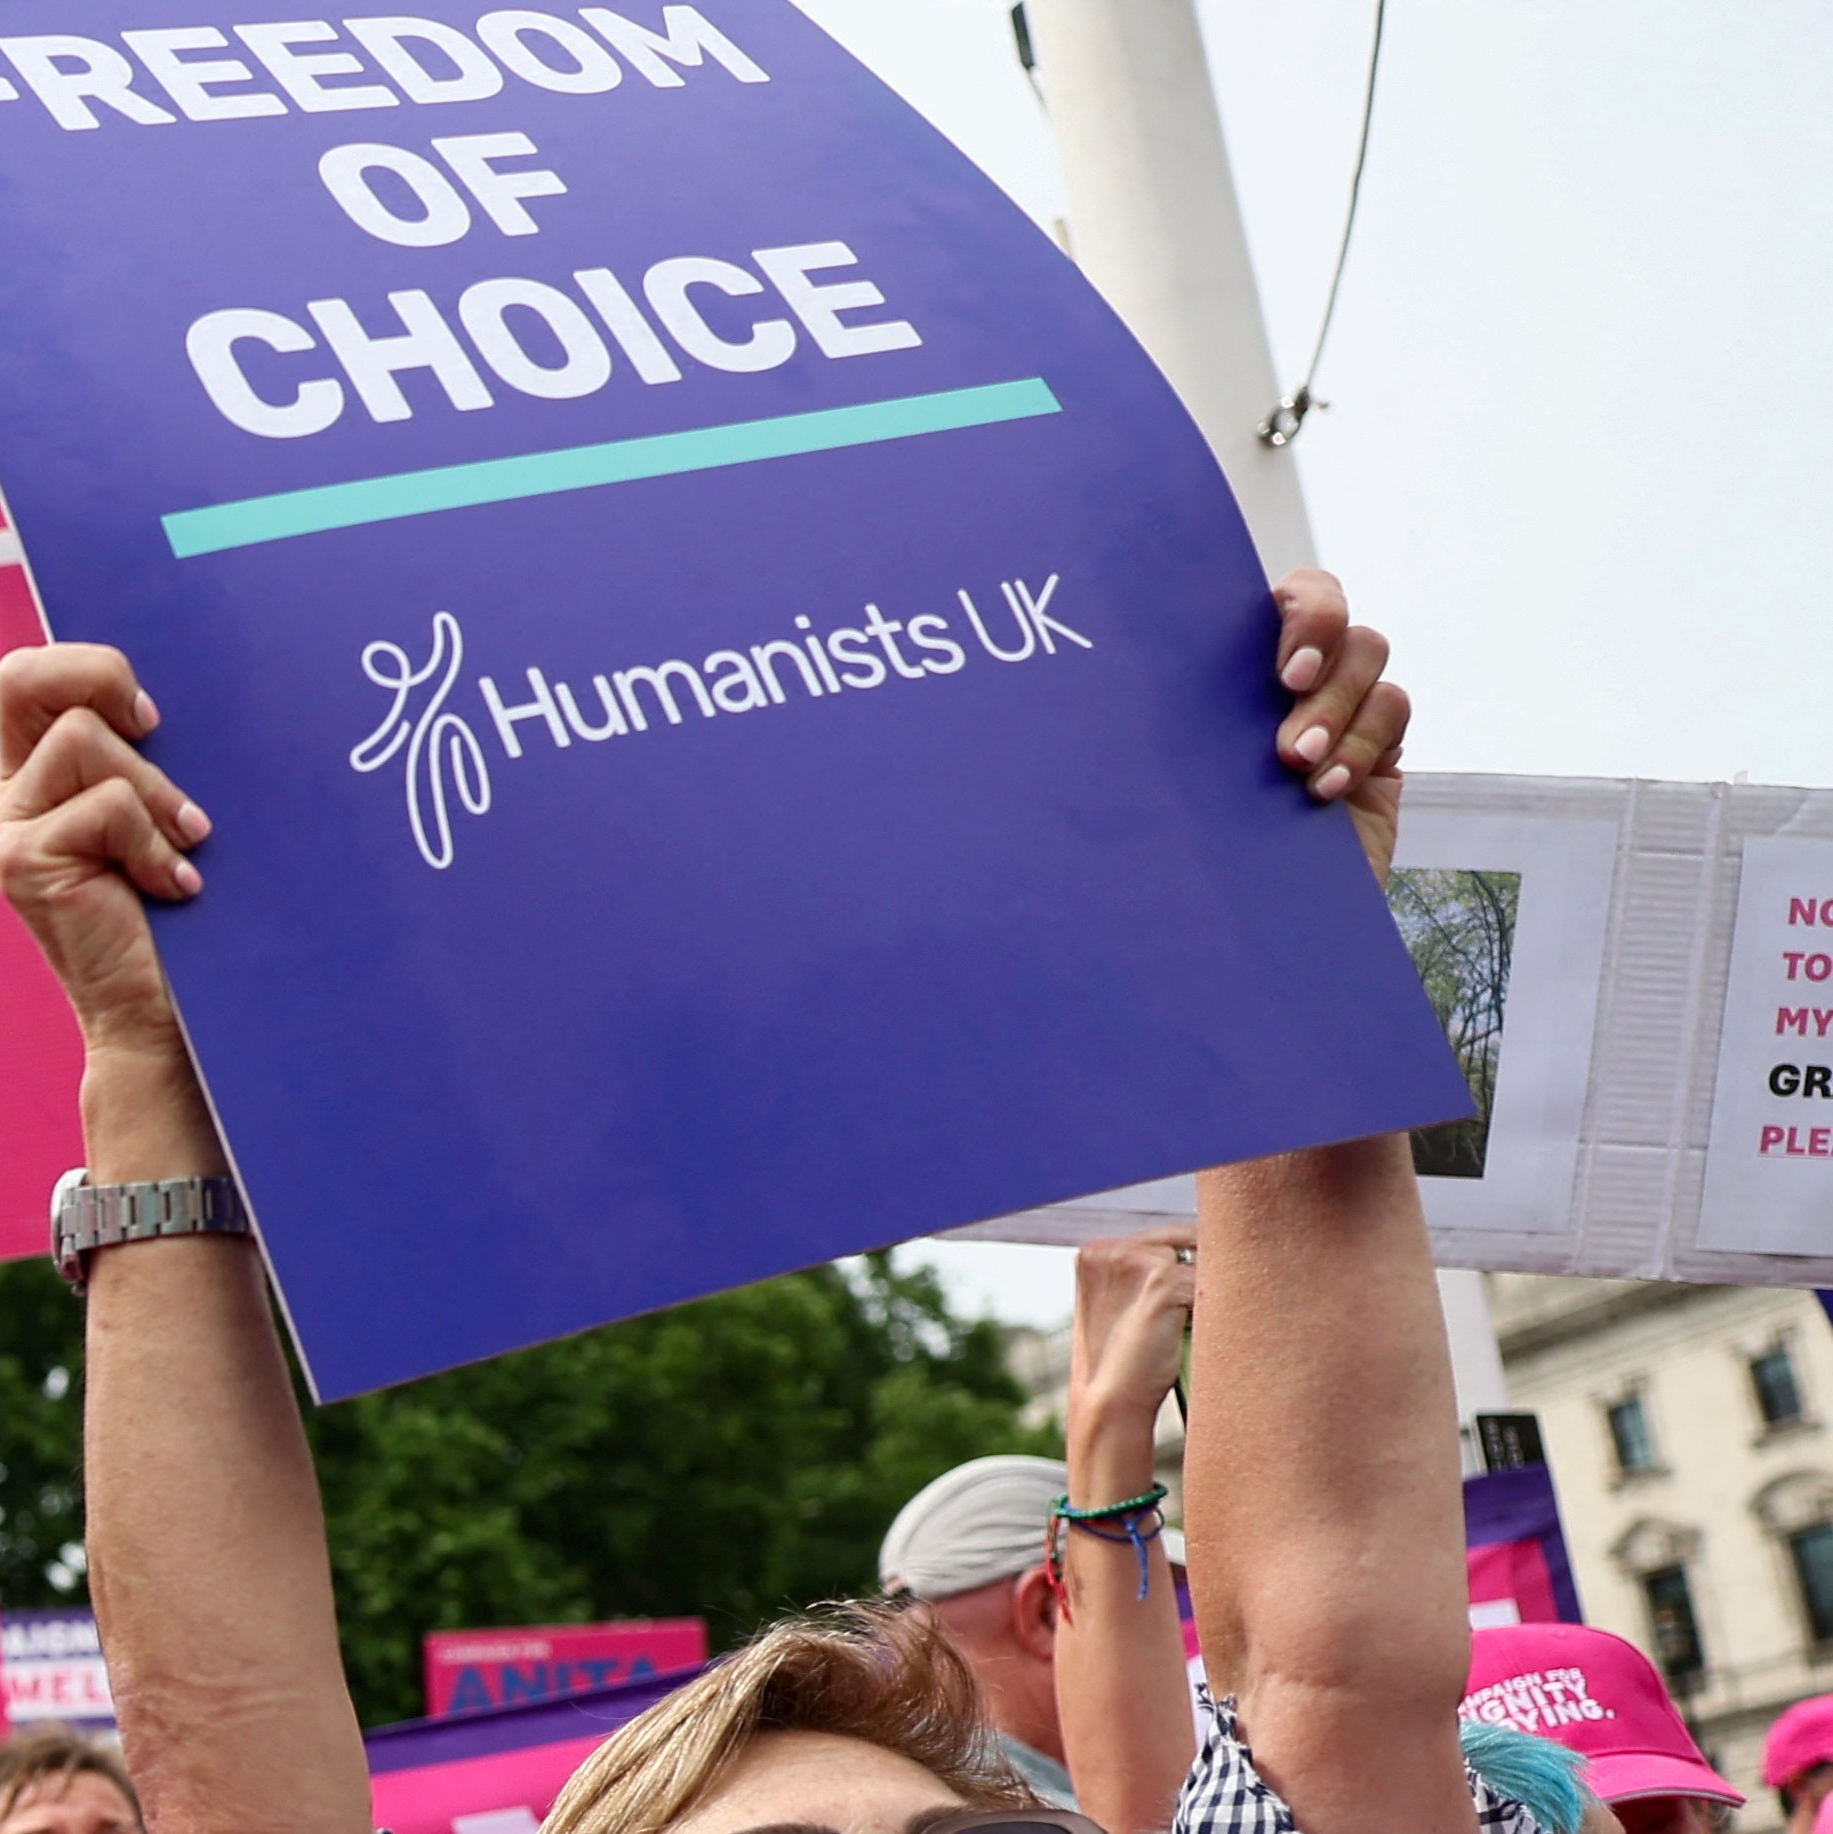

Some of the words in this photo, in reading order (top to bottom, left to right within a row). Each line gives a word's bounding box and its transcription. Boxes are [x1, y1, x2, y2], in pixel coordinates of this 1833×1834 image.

[317, 131, 568, 247] OF
[184, 240, 924, 440] CHOICE
[478, 602, 966, 759] Humanists
[956, 573, 1094, 664] UK
[1768, 1062, 1833, 1098] GR
[1759, 1124, 1833, 1157] PLE
